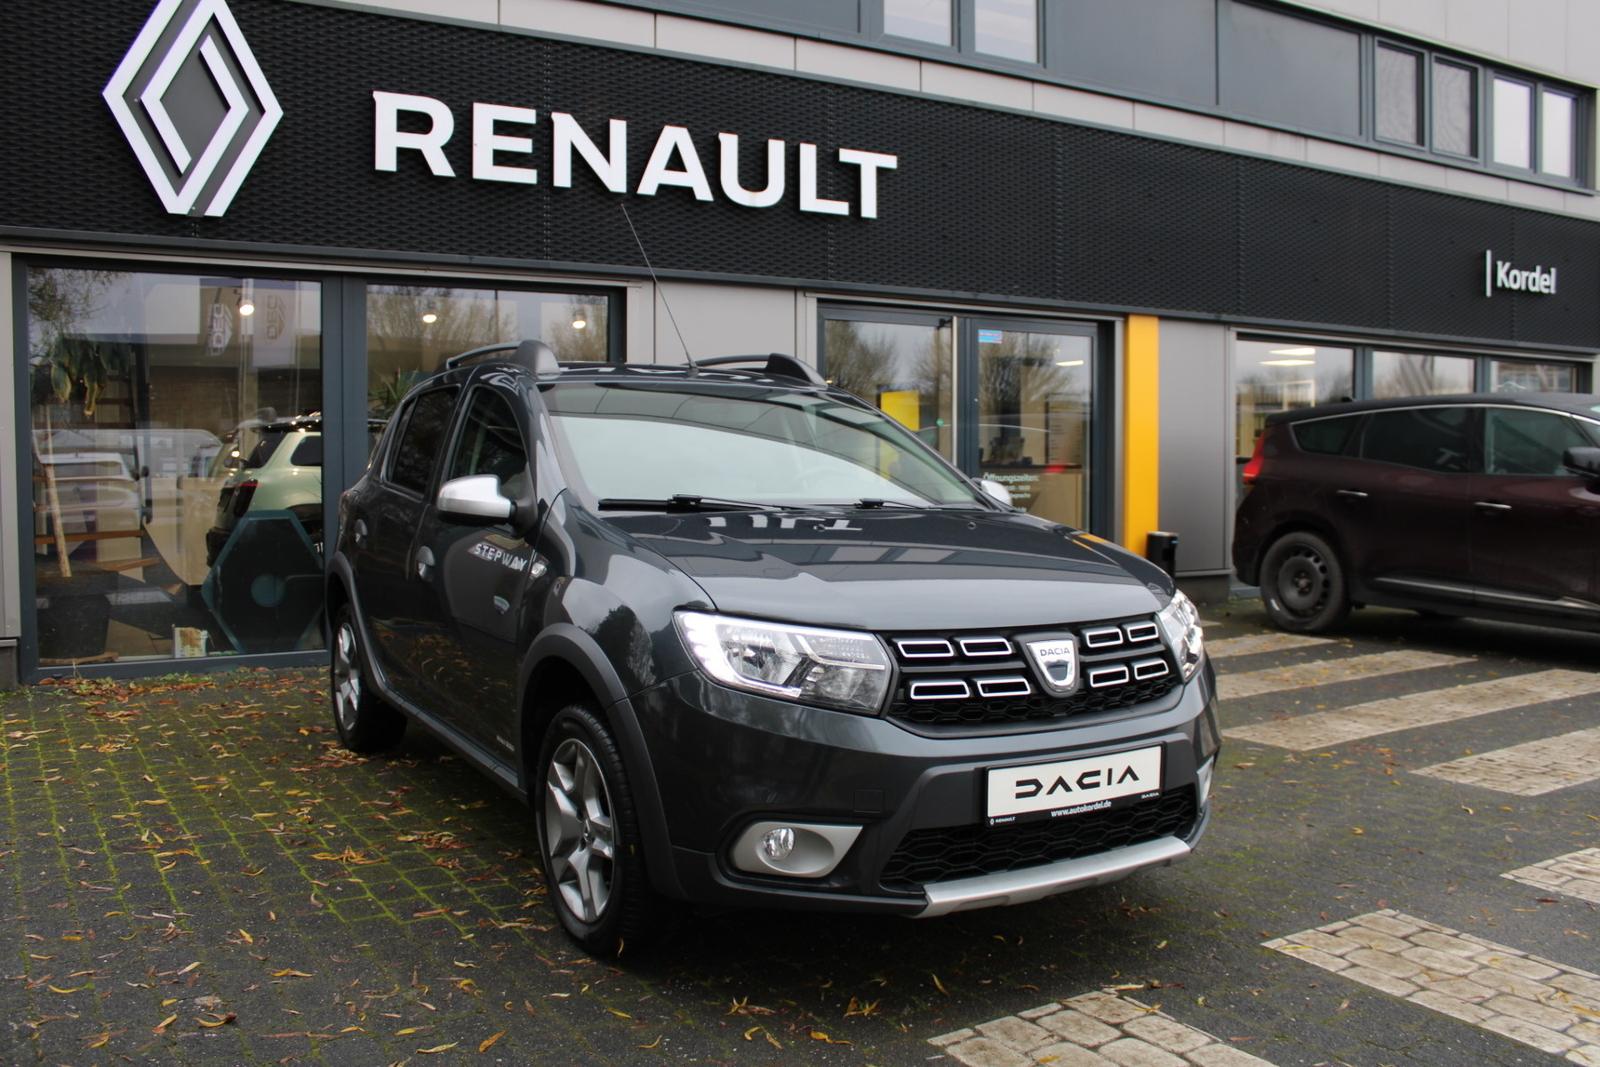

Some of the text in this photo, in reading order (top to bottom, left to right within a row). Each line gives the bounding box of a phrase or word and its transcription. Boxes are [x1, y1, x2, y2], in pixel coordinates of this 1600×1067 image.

[373, 90, 898, 219] RENAULT
[1496, 260, 1557, 294] Kordel
[474, 543, 527, 571] STEPWAY
[1040, 647, 1071, 656] DACIA
[1015, 765, 1139, 799] DACIA
[1051, 800, 1112, 817] www.autokordel.de
